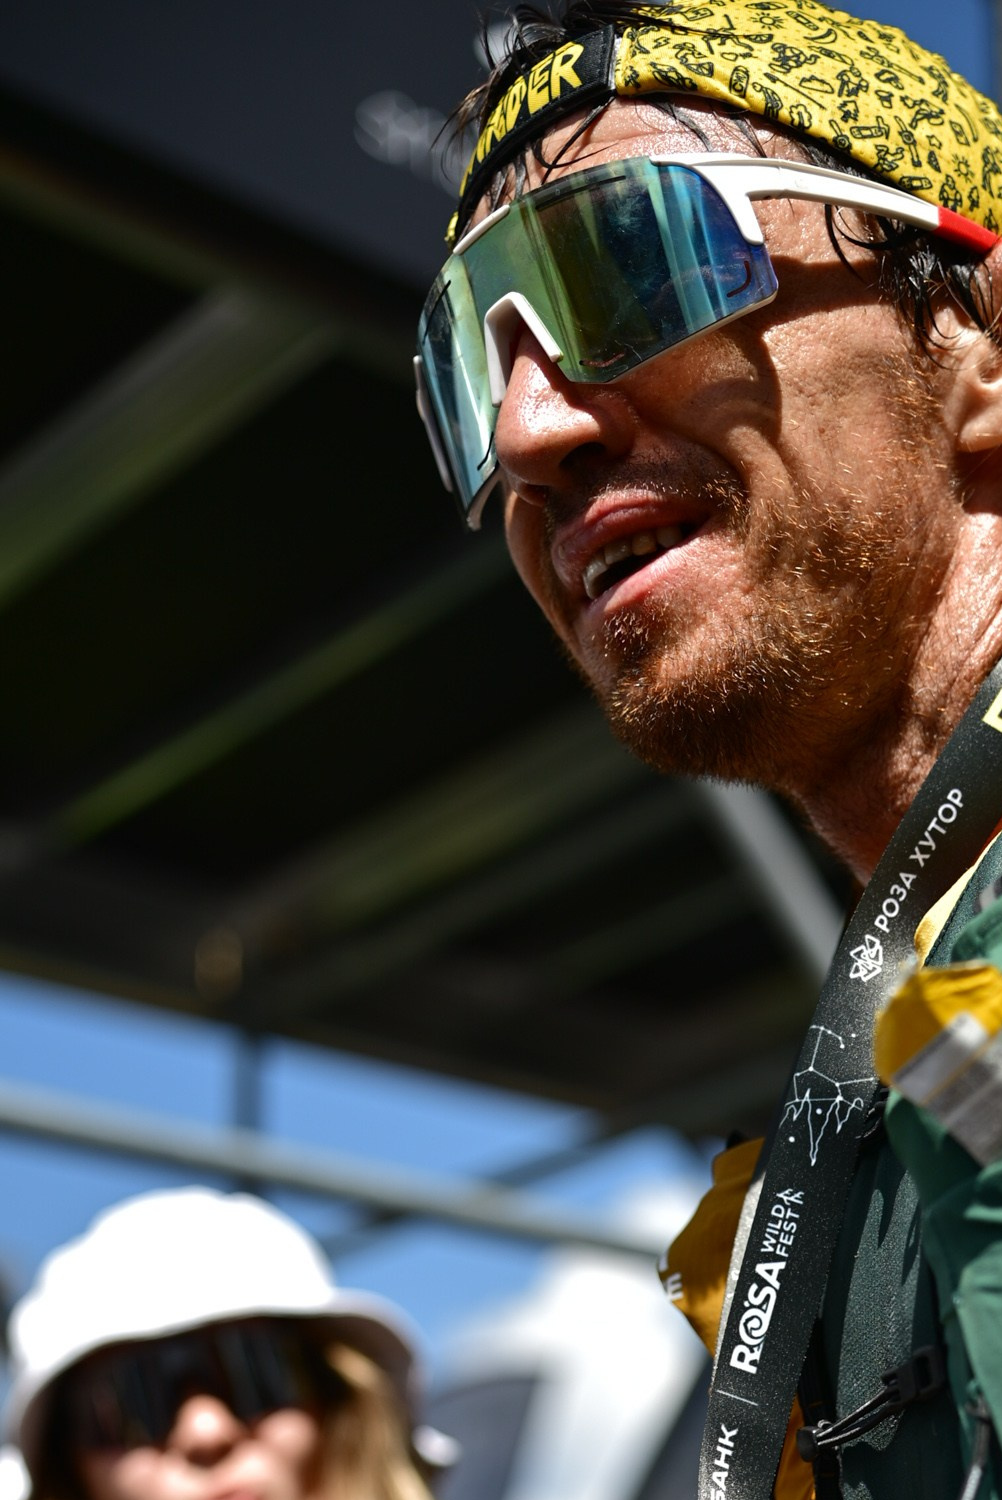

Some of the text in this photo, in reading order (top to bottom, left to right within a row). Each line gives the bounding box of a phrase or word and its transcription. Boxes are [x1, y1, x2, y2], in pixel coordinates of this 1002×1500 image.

[873, 788, 964, 933] РОЗА ХУТОР
[760, 1202, 786, 1254] WILD
[774, 1210, 801, 1258] FEST
[728, 1261, 787, 1374] ROSA
